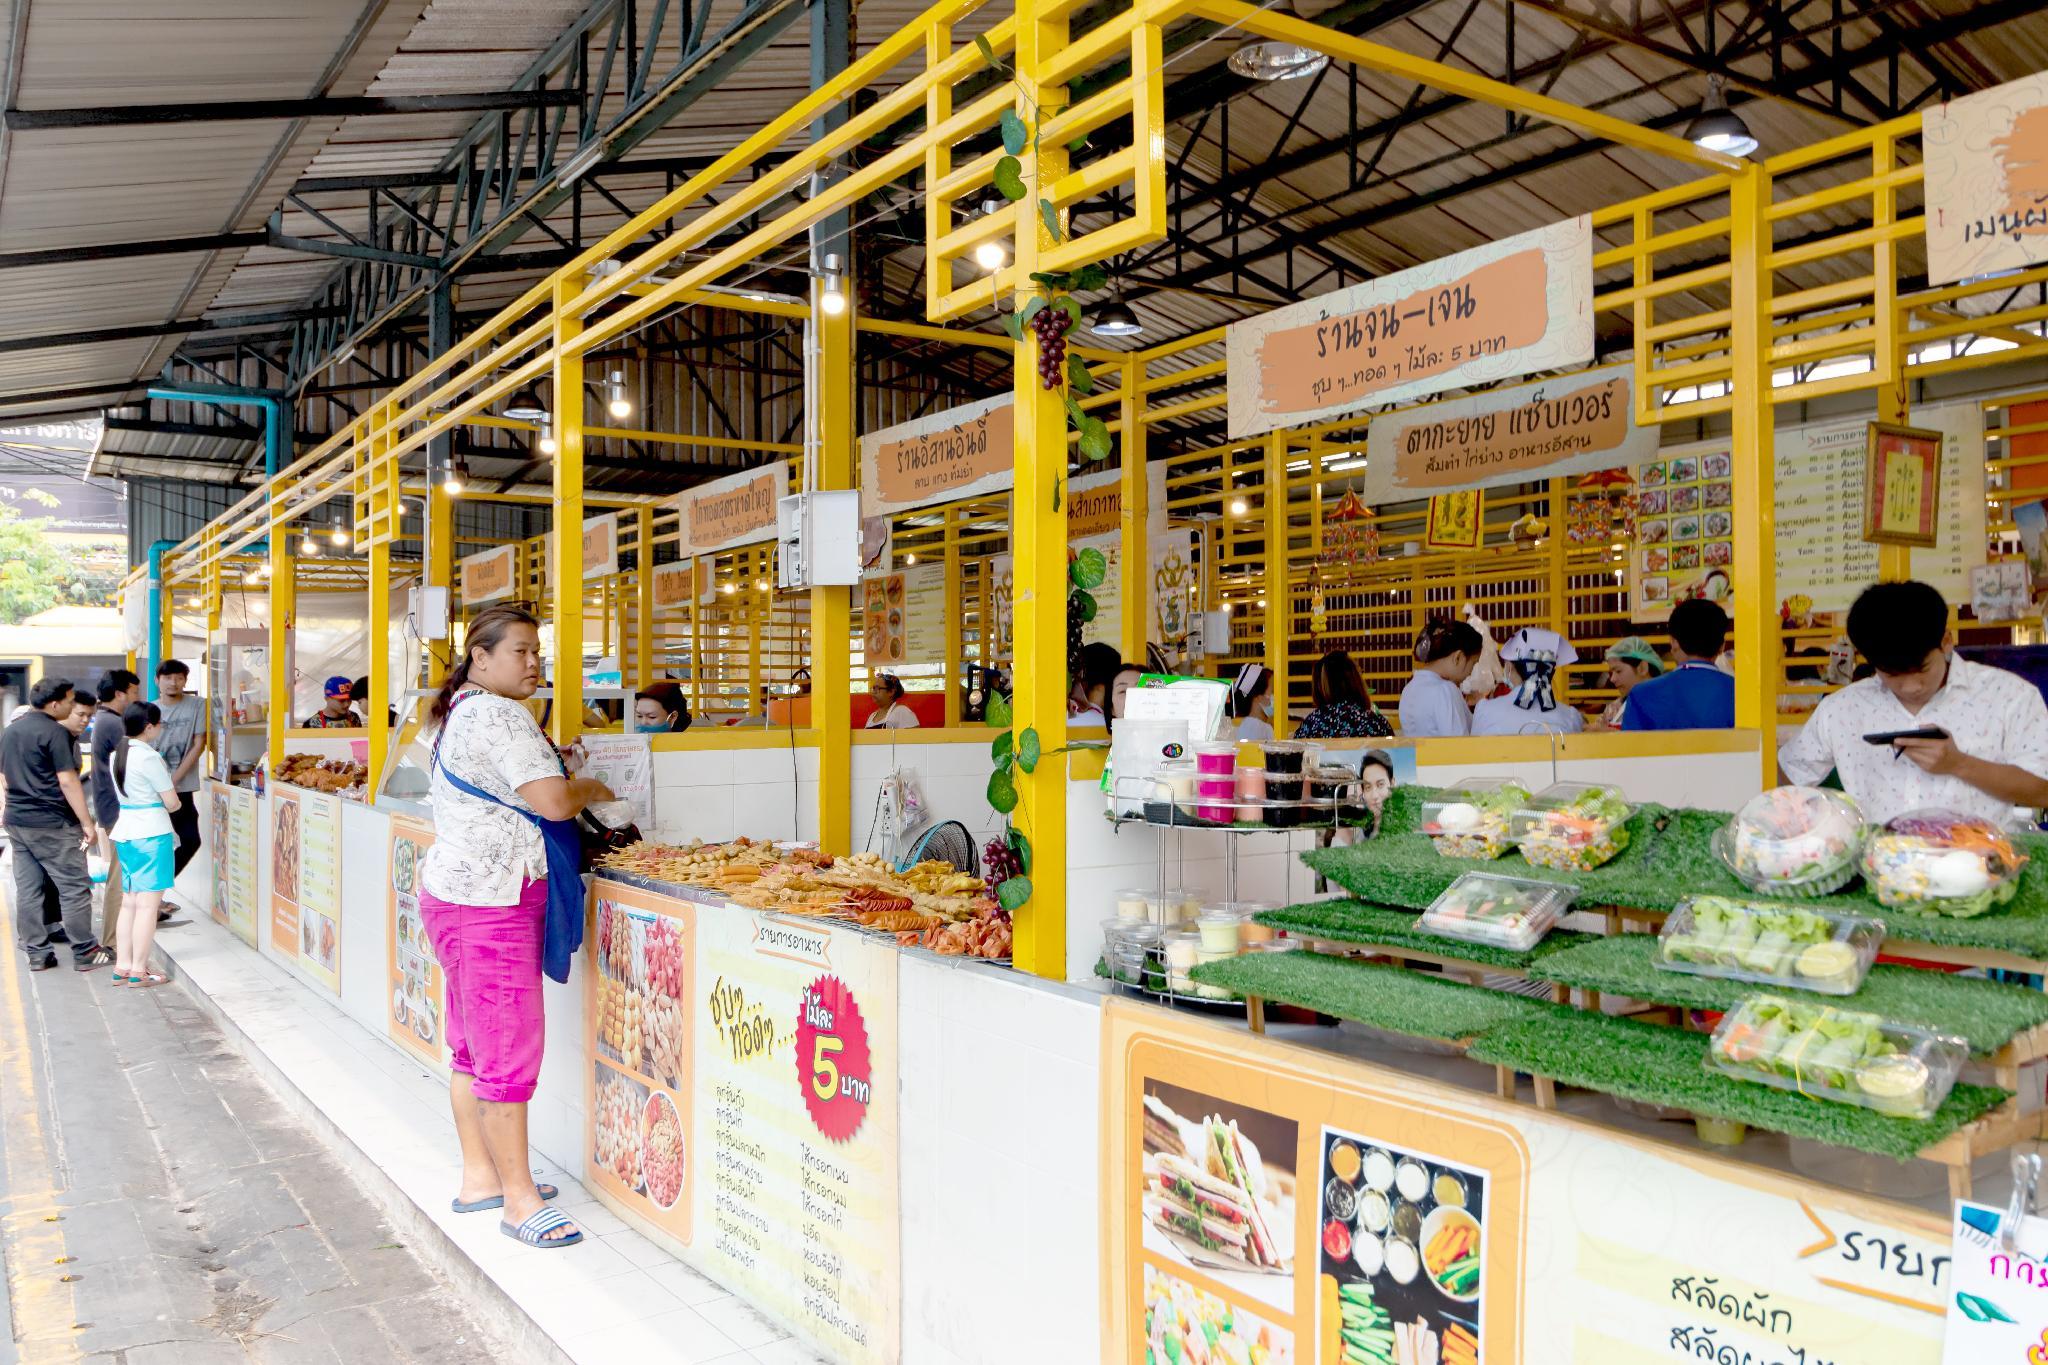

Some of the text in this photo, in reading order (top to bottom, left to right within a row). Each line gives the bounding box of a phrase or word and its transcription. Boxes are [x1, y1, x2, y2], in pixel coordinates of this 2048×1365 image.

[1312, 375, 1331, 404] ชุบ
[1405, 344, 1444, 373] ไม้ละ
[1451, 345, 1463, 361] 5
[1469, 335, 1507, 358] บาท
[1407, 413, 1496, 455] ตากะยาย
[1509, 434, 1592, 461] อาหารอีสาน
[759, 925, 823, 957] รายการอาหาร
[802, 986, 834, 1030] ไม้ละ
[811, 1034, 871, 1105] 5 บาท
[1671, 1273, 1793, 1335] สลัดผัก
